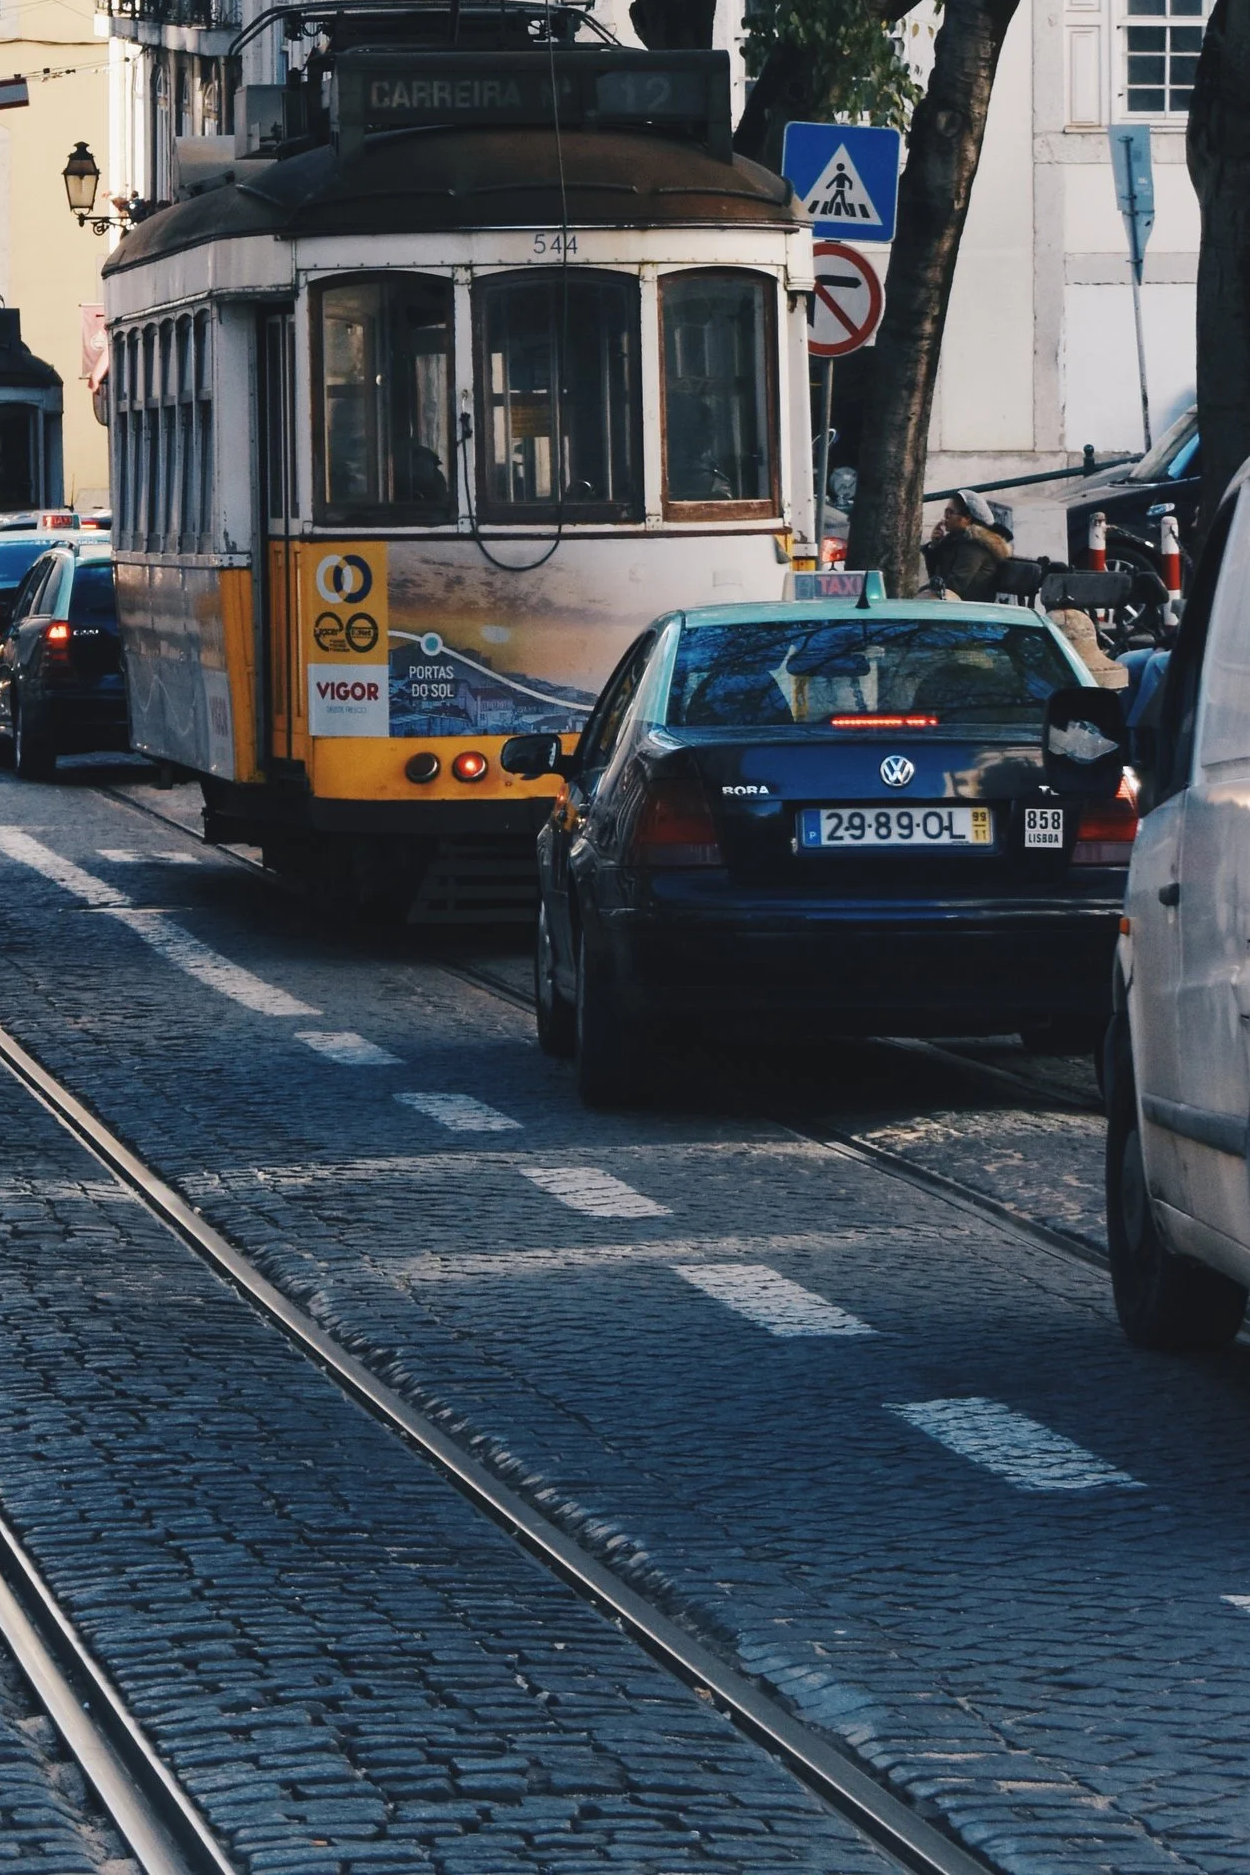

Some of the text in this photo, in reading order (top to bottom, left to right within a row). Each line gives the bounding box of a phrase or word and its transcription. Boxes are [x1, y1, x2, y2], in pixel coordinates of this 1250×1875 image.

[370, 78, 522, 109] CARREIRA
[621, 77, 672, 112] 12
[533, 233, 578, 255] 544
[817, 575, 863, 595] TAXI
[409, 666, 454, 679] PORTAS
[316, 682, 379, 701] VIGOR
[411, 683, 454, 697] DO SOL
[722, 786, 769, 795] BORA
[972, 811, 987, 822] 99
[1027, 810, 1061, 829] 858
[809, 831, 817, 840] P
[973, 829, 987, 840] 11
[1028, 832, 1059, 844] LISBOA
